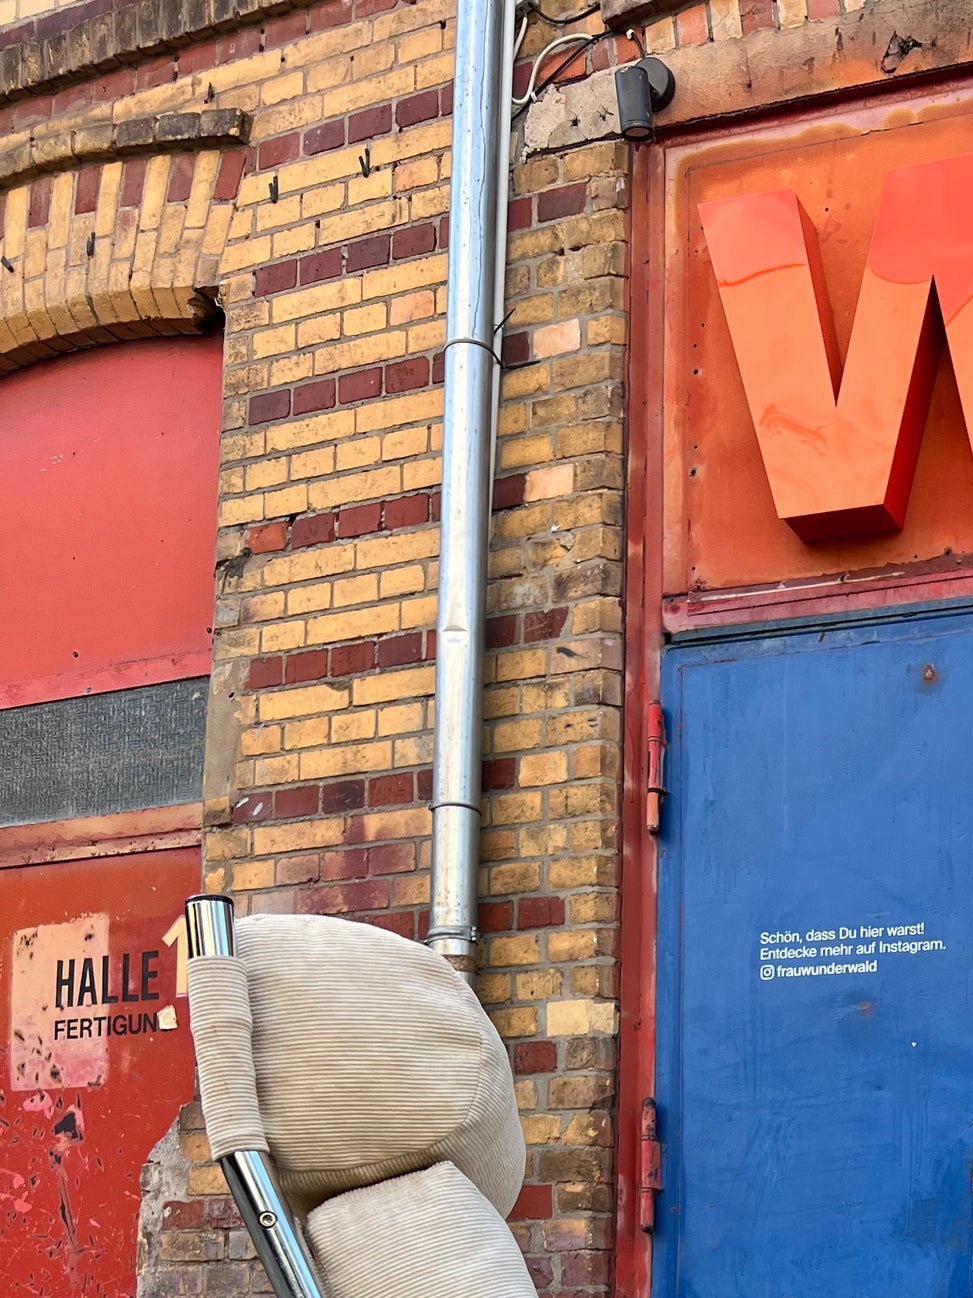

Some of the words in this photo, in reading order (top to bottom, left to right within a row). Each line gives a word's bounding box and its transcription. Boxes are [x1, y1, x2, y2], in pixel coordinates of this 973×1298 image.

[760, 930, 802, 945] Schön,
[806, 929, 836, 942] dass
[839, 927, 857, 940] Du
[860, 925, 884, 938] hier
[886, 922, 925, 937] warst!
[55, 950, 160, 1008] HALLE
[162, 914, 190, 998] 1
[760, 946, 817, 960] Entdecke
[820, 943, 853, 957] mehr
[856, 942, 876, 955] auf
[879, 939, 946, 954] Instagram.
[777, 960, 878, 977] frauwunderwald
[54, 1012, 175, 1041] FERTIGUN
